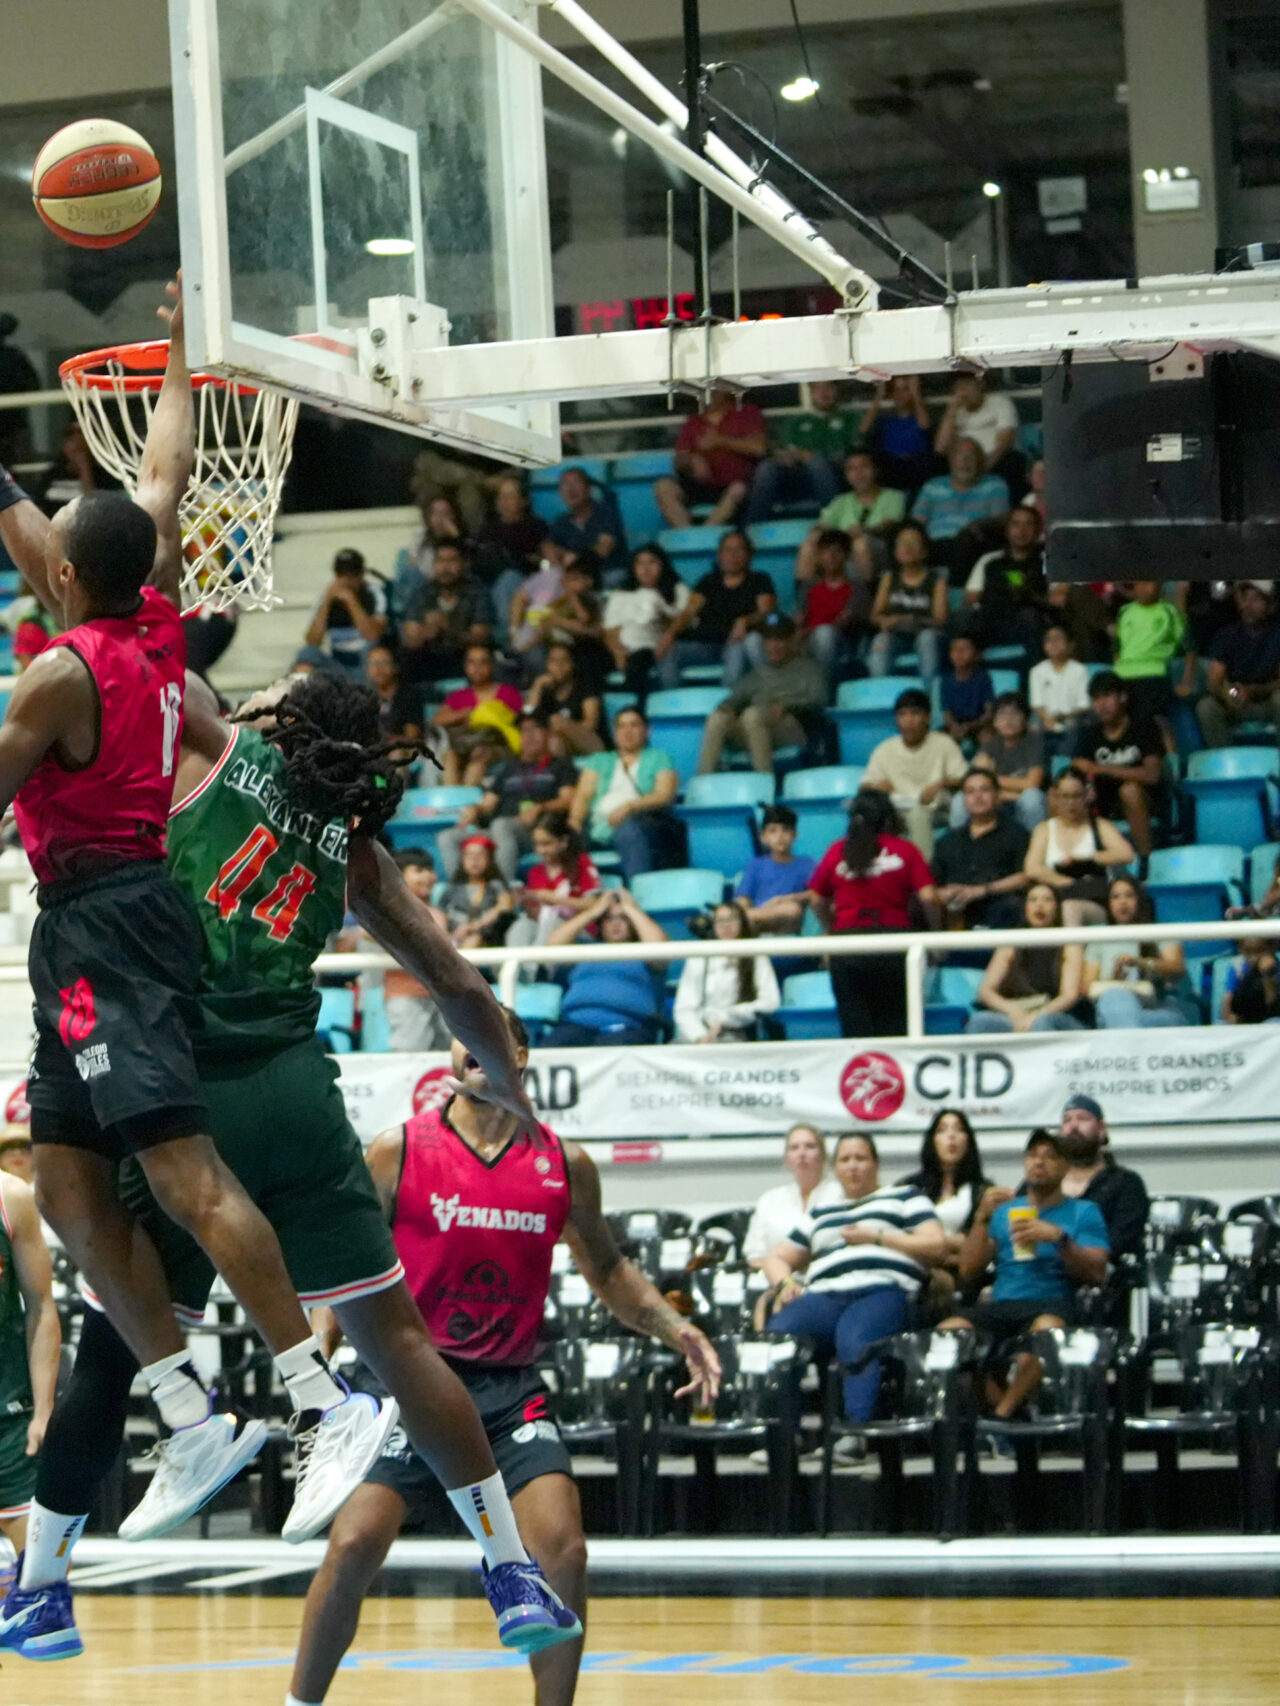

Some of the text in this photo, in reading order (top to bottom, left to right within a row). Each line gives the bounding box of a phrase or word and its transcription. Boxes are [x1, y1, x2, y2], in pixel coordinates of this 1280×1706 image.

[224, 757, 348, 864] ALEXANER
[205, 823, 317, 943] 44
[59, 976, 97, 1047] 10
[616, 1067, 801, 1087] SIEMPRE GRANDES
[914, 1052, 1015, 1100] CID
[1054, 1051, 1246, 1073] SIEMPRE GRANDES
[521, 1064, 580, 1112] AD
[631, 1091, 786, 1109] SIEMPRE LOBOS
[1067, 1075, 1230, 1096] SIEMPRE LOBOS
[430, 1192, 548, 1233] VENADOS
